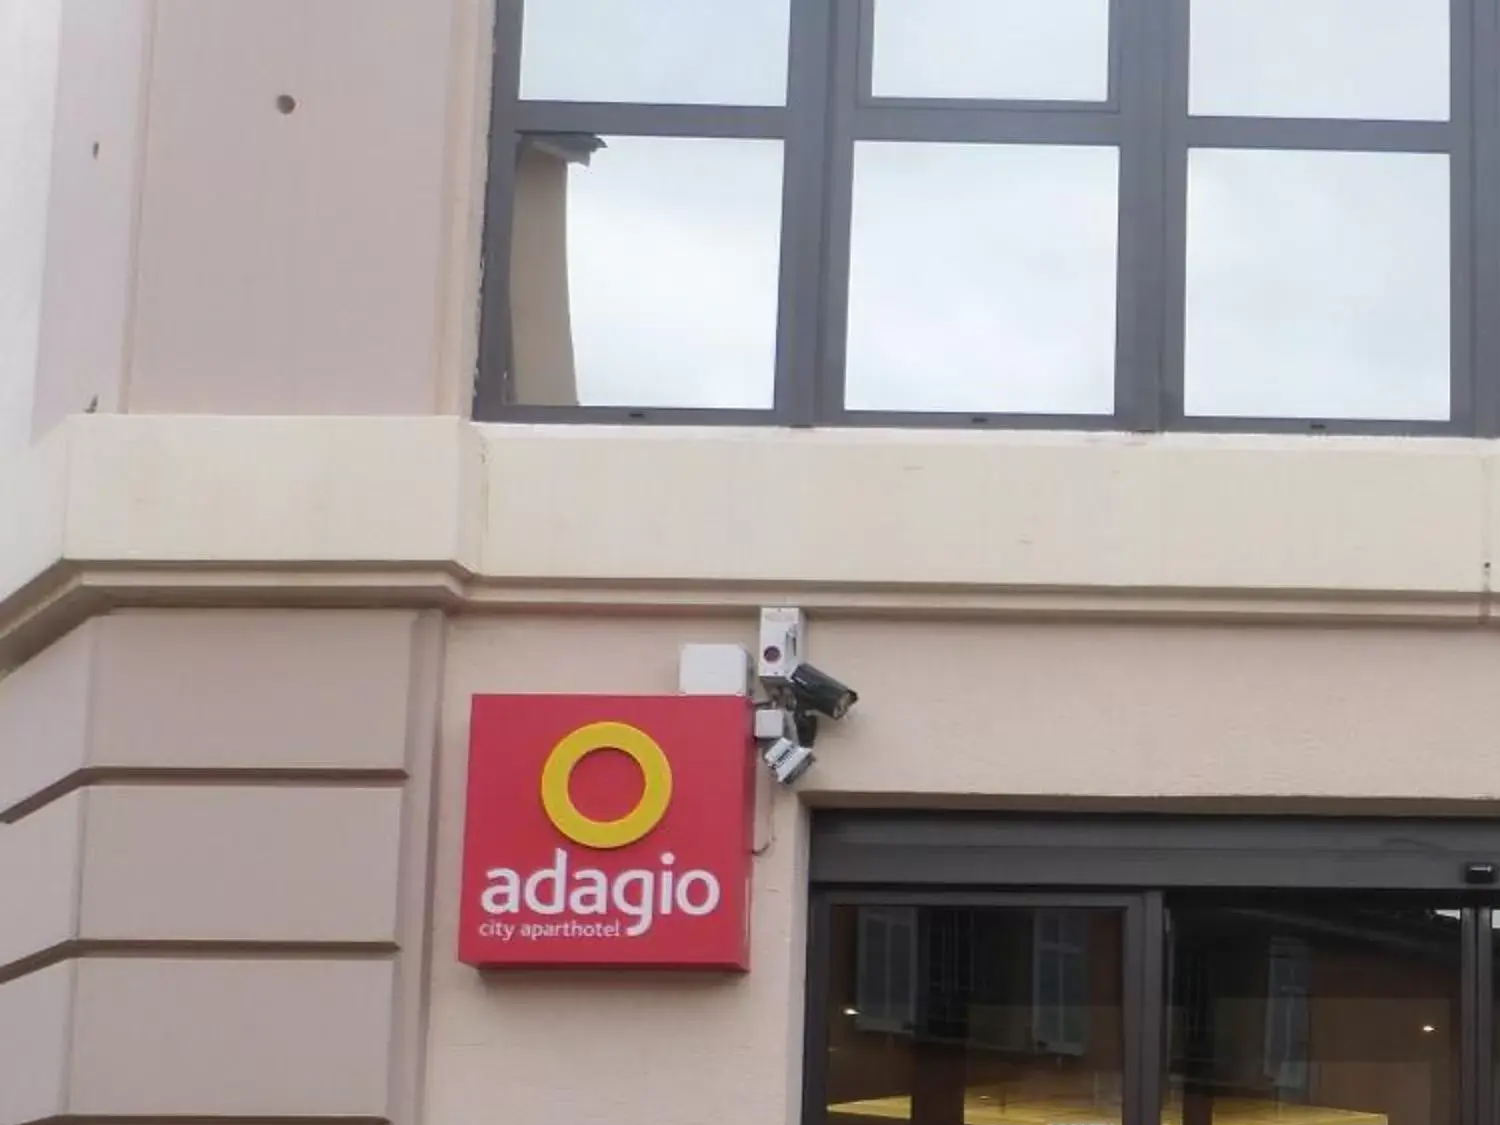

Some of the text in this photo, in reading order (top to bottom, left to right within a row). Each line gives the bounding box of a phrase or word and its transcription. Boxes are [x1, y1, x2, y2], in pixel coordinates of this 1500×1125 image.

[480, 848, 720, 936] adagio
[479, 919, 621, 941] city aparthotel
